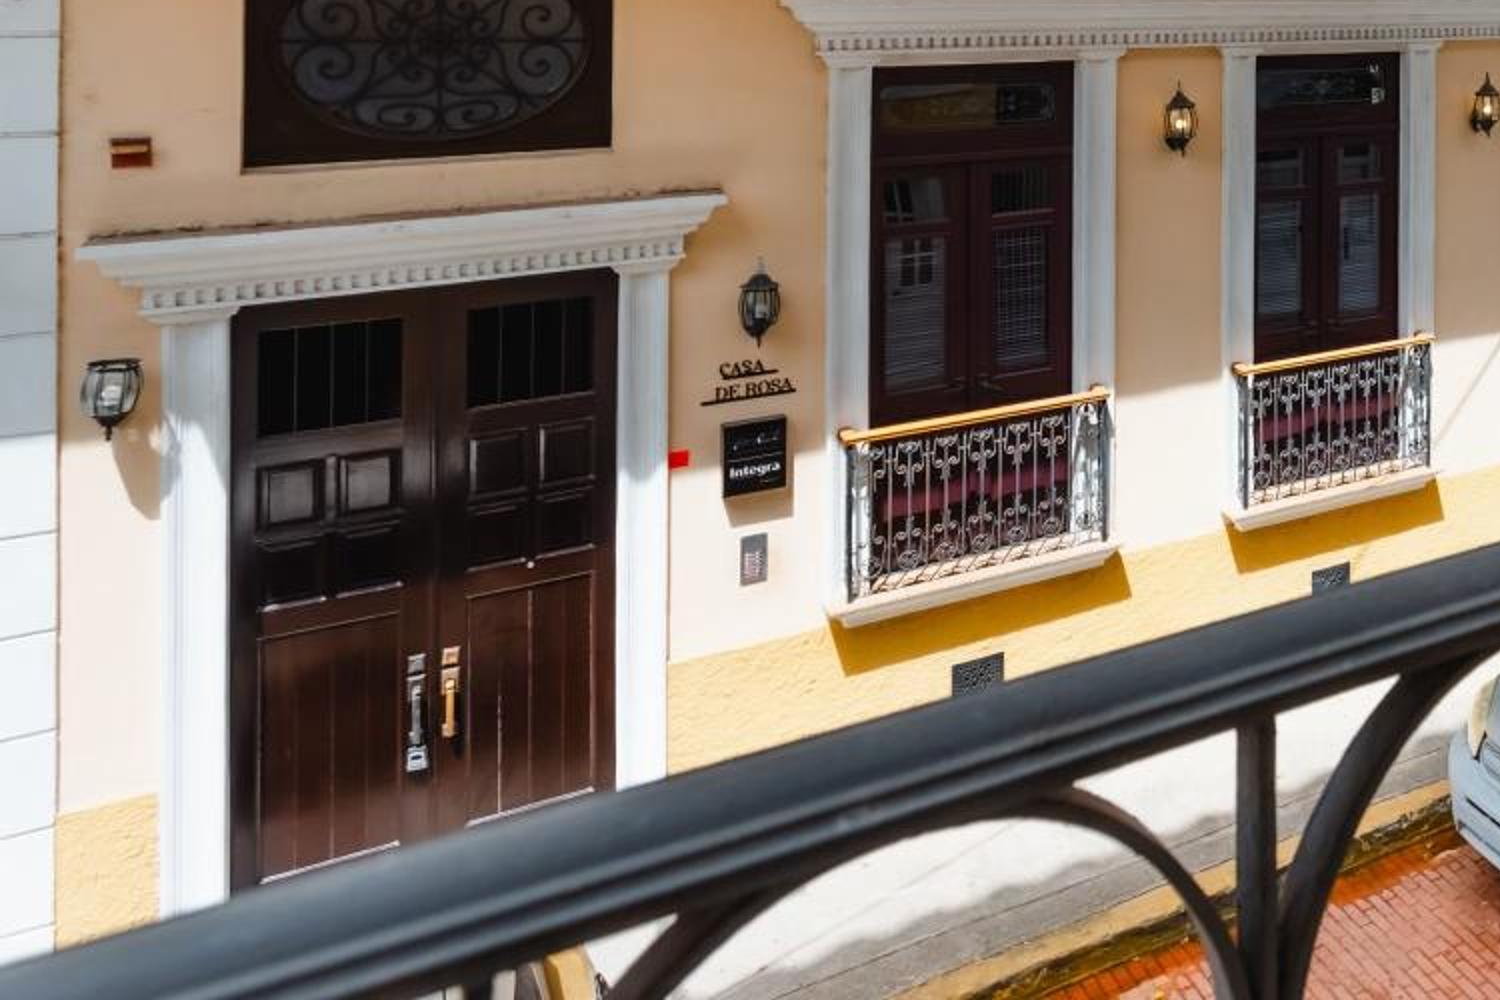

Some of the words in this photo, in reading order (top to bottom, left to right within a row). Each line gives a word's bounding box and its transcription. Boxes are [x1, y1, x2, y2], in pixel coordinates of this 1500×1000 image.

[719, 359, 765, 378] CASA
[715, 383, 740, 401] DE
[746, 378, 794, 396] ROSA
